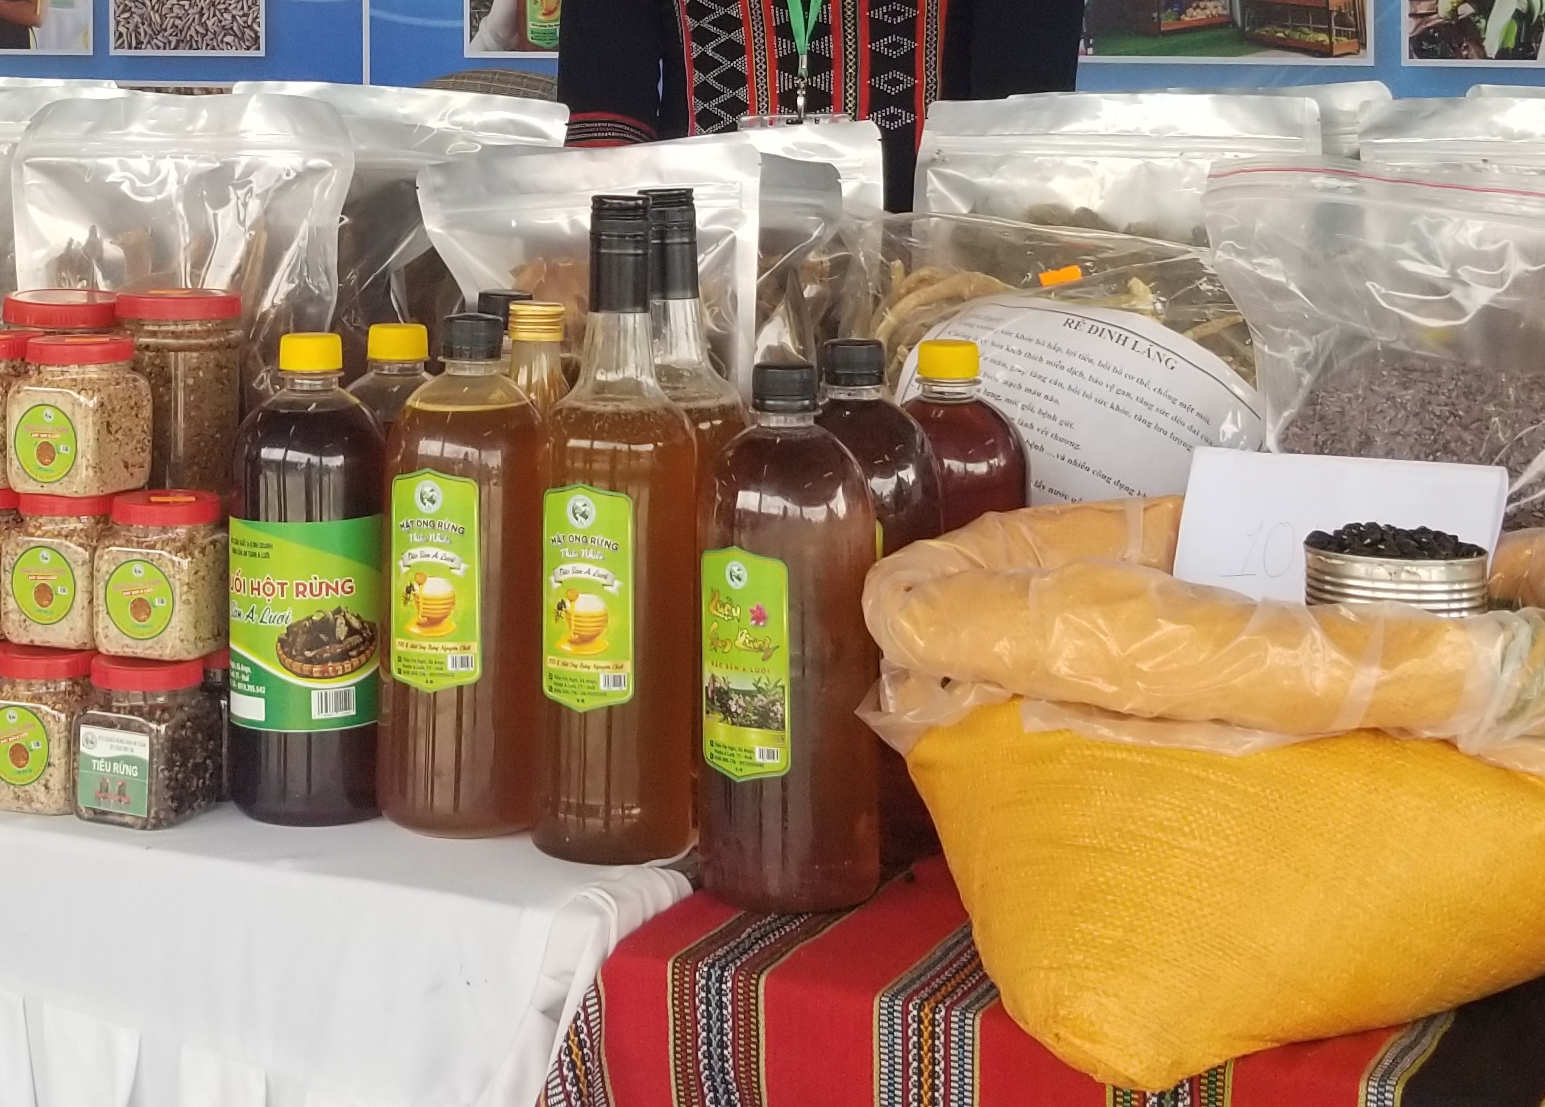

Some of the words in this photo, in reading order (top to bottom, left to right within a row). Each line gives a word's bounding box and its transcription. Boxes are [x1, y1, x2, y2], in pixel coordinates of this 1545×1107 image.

[417, 519, 435, 528] ONG
[568, 534, 588, 544] ONG
[250, 574, 288, 603] HỘT
[295, 575, 354, 599] RỪNG
[92, 758, 111, 772] TIÊU
